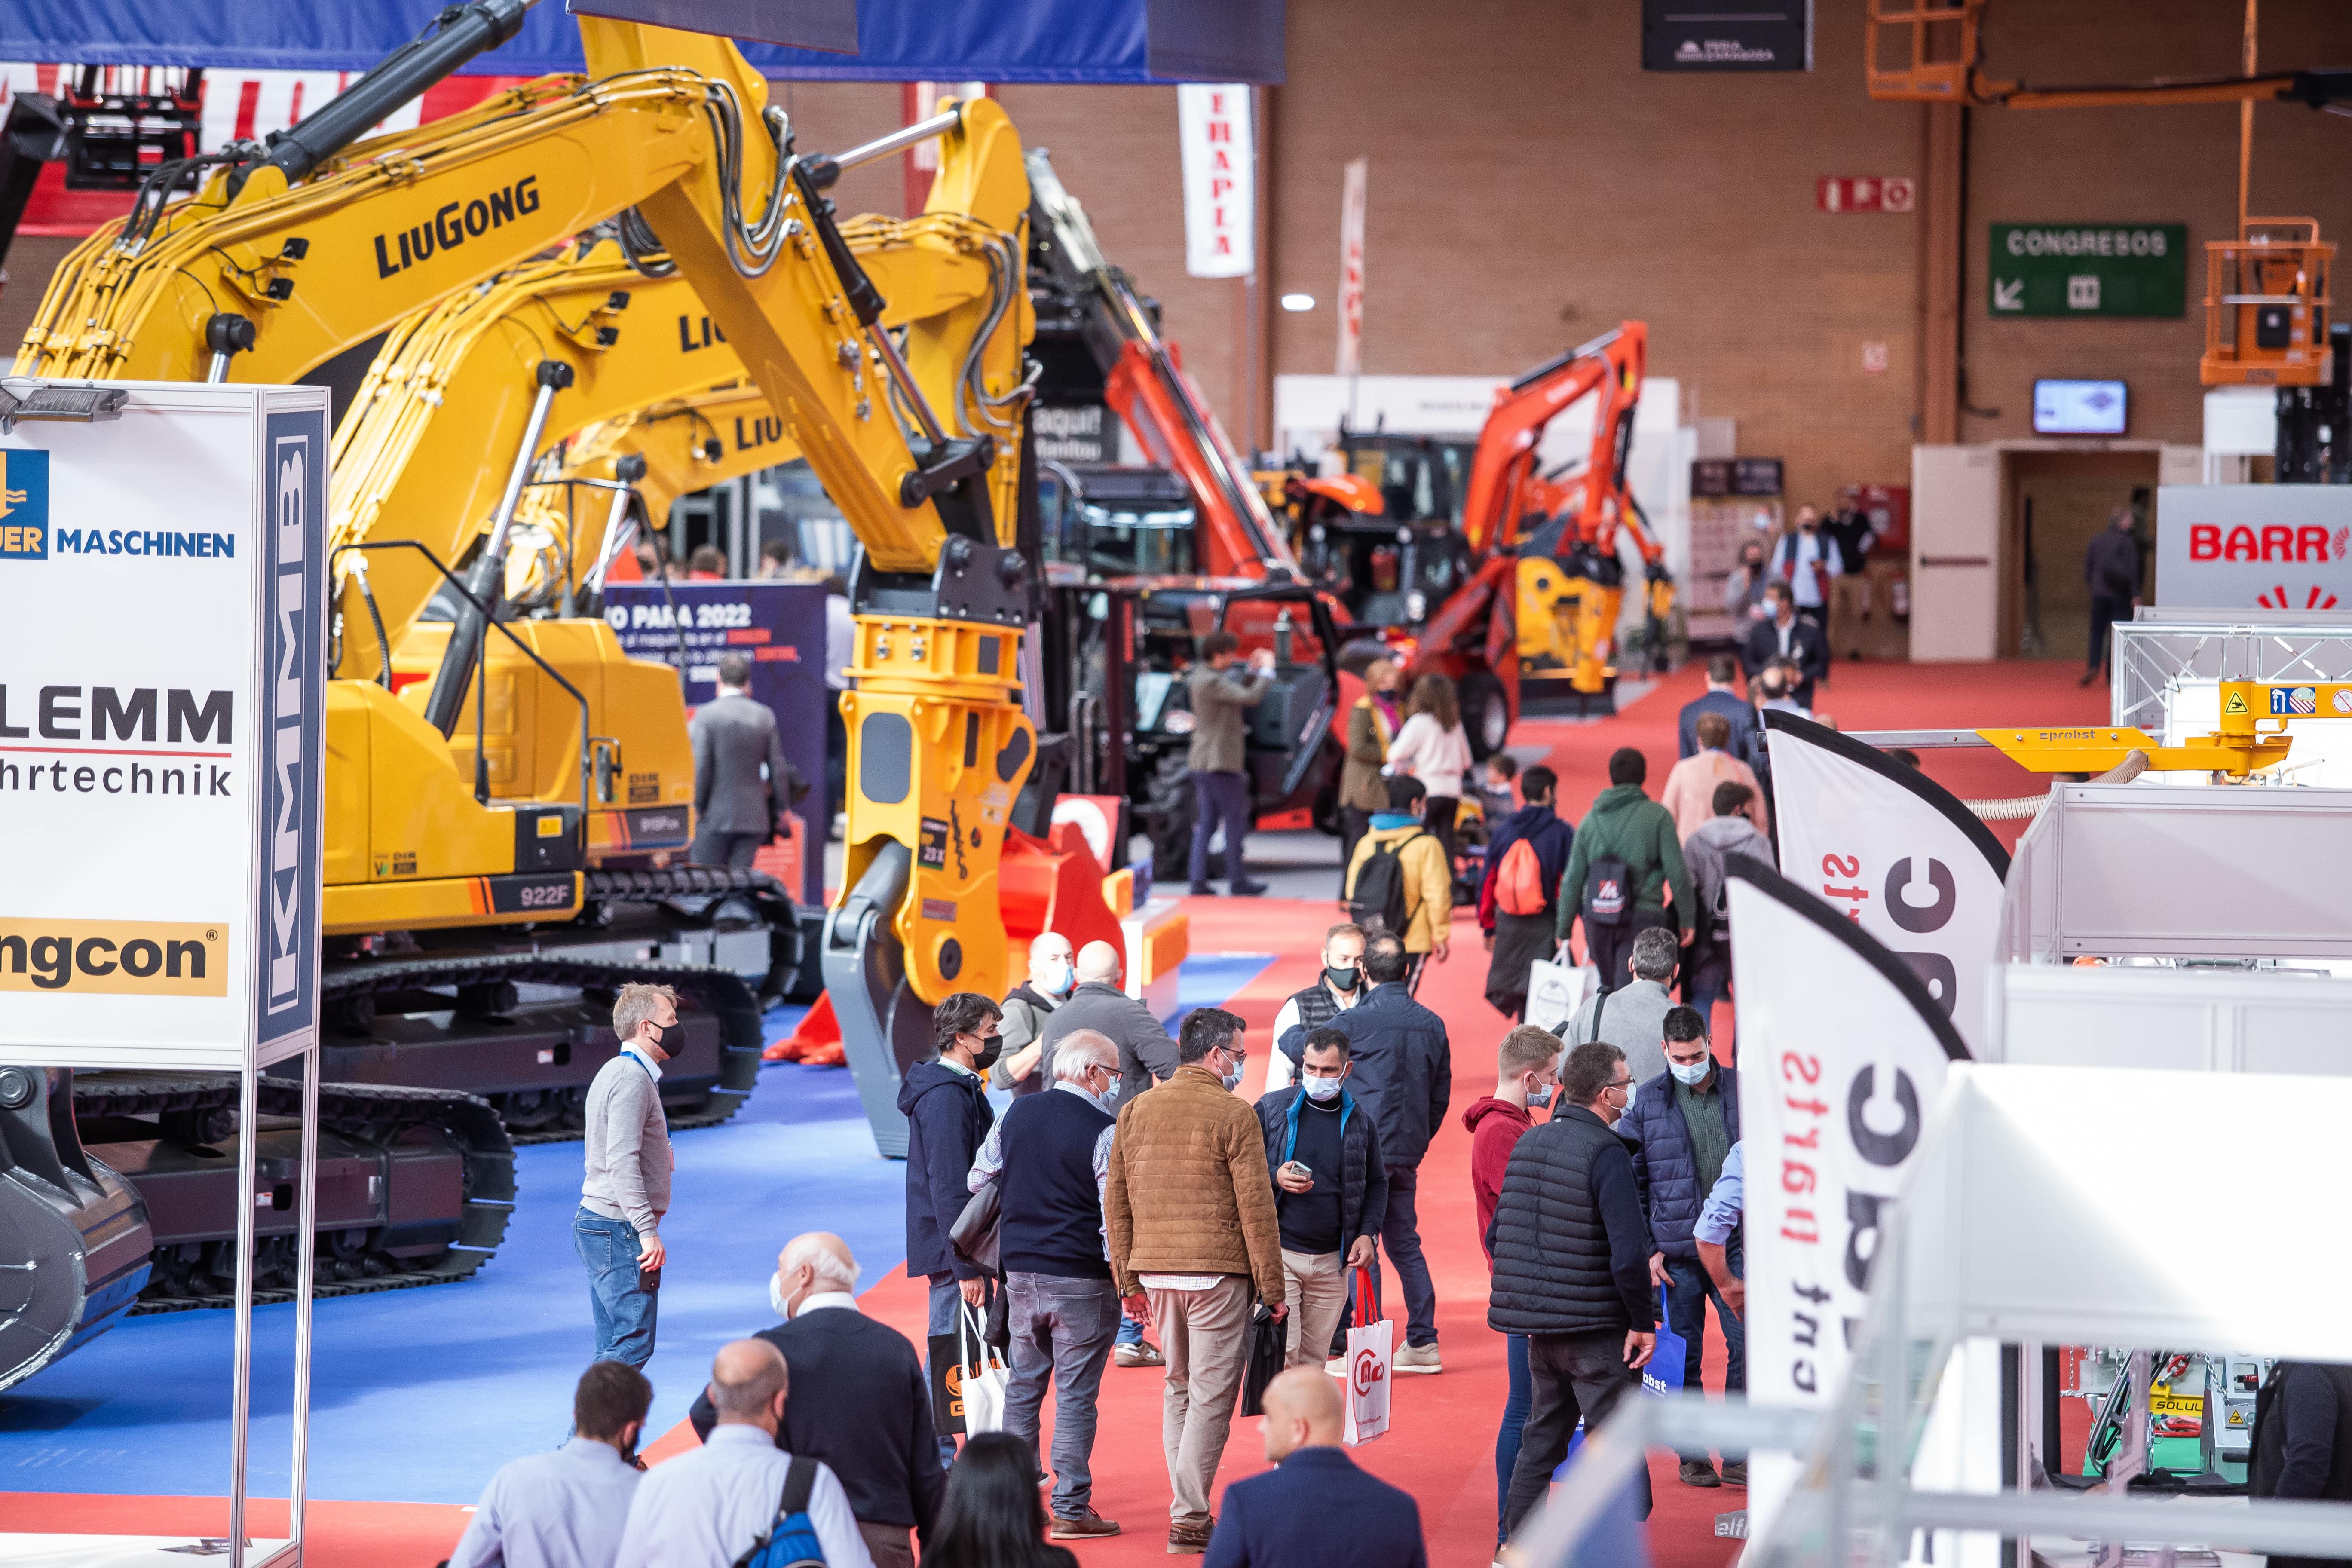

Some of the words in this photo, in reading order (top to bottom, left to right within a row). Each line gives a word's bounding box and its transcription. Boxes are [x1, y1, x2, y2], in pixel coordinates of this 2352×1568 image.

[374, 175, 540, 279] LIUGONG
[2006, 230, 2168, 256] CONGRESOS
[57, 528, 235, 558] MASCHINEN
[696, 603, 752, 628] 2022
[271, 450, 304, 998] KMMB
[2049, 729, 2096, 741] probst
[521, 885, 570, 906] 922F
[1643, 1372, 1667, 1393] obst
